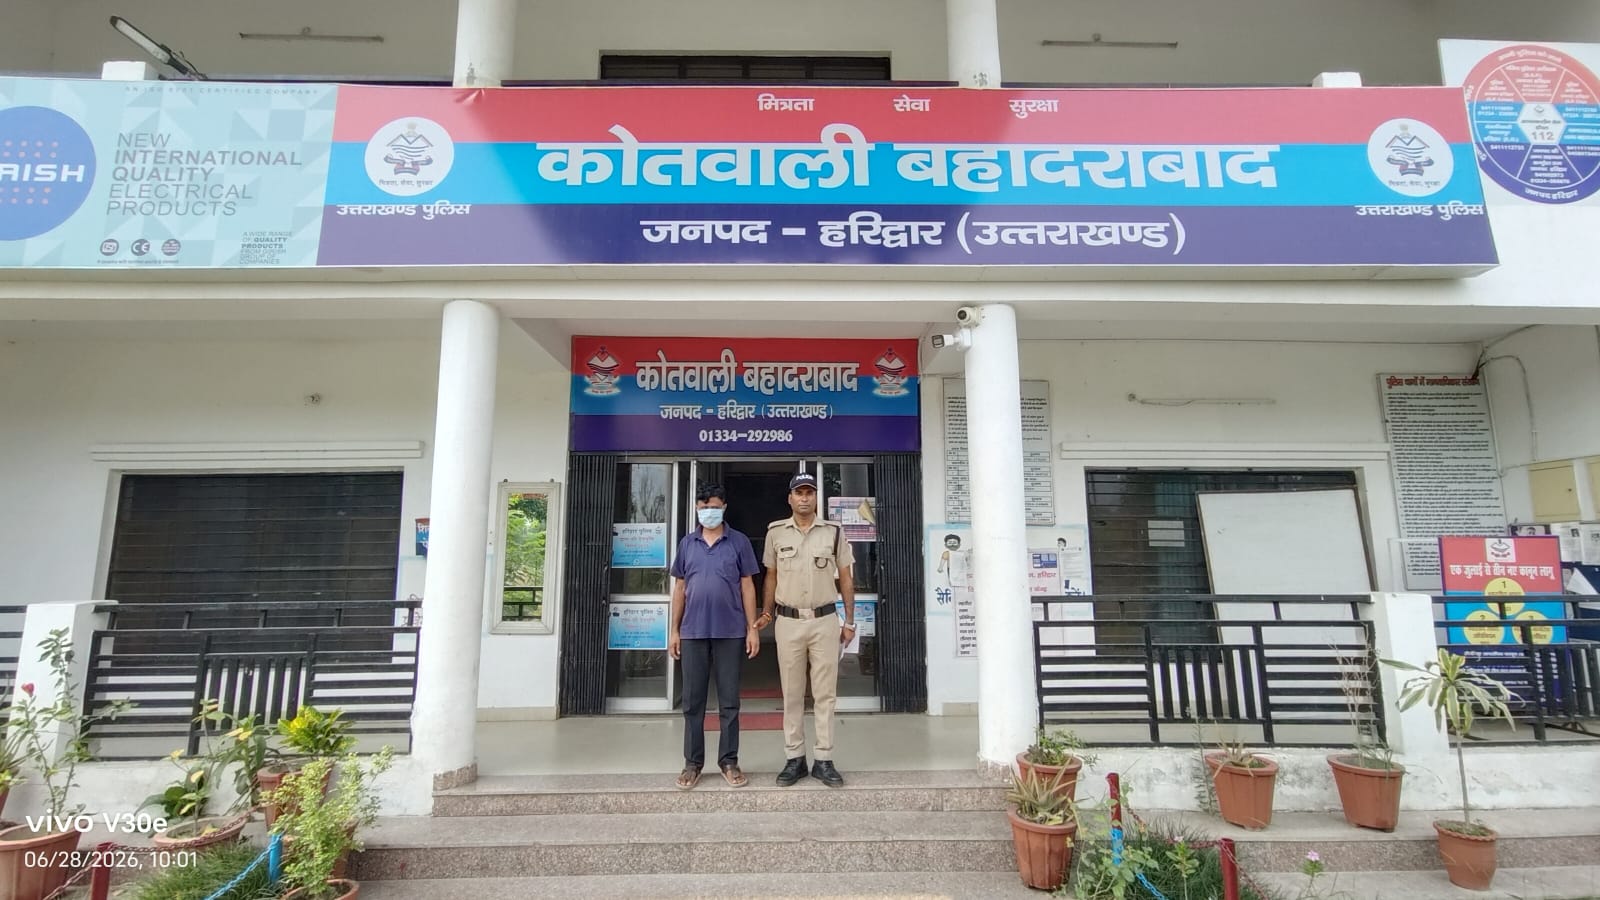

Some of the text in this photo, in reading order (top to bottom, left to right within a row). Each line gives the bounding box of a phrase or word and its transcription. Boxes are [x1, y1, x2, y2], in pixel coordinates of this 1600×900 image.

[757, 93, 815, 111] मित्रता
[893, 94, 931, 112] सेवा
[1009, 98, 1059, 119] सुरक्षा
[117, 132, 171, 148] NEW
[1532, 132, 1554, 141] 112
[114, 150, 303, 166] INTERNATIONAL
[536, 123, 1280, 193] कोतवाली बहादराबाद
[112, 166, 215, 182] QUALITY
[109, 184, 253, 199] ELECTRICAL
[106, 201, 236, 216] PRODUCTS
[336, 199, 472, 221] उत्तराखण्ड पुलिस
[1354, 199, 1485, 221] उत्तराखण्ड पुलिस
[640, 220, 771, 244] जनपद
[818, 211, 946, 248] हरिद्वार
[957, 212, 1186, 255] (उत्तराखण्ड)
[132, 242, 150, 253] CE
[635, 348, 860, 396] कोतवाली बहादराबाद
[659, 404, 703, 420] जनपद
[717, 399, 756, 421] हरिद्वार
[699, 429, 793, 443] 01334-292986
[1502, 580, 1507, 589] 1
